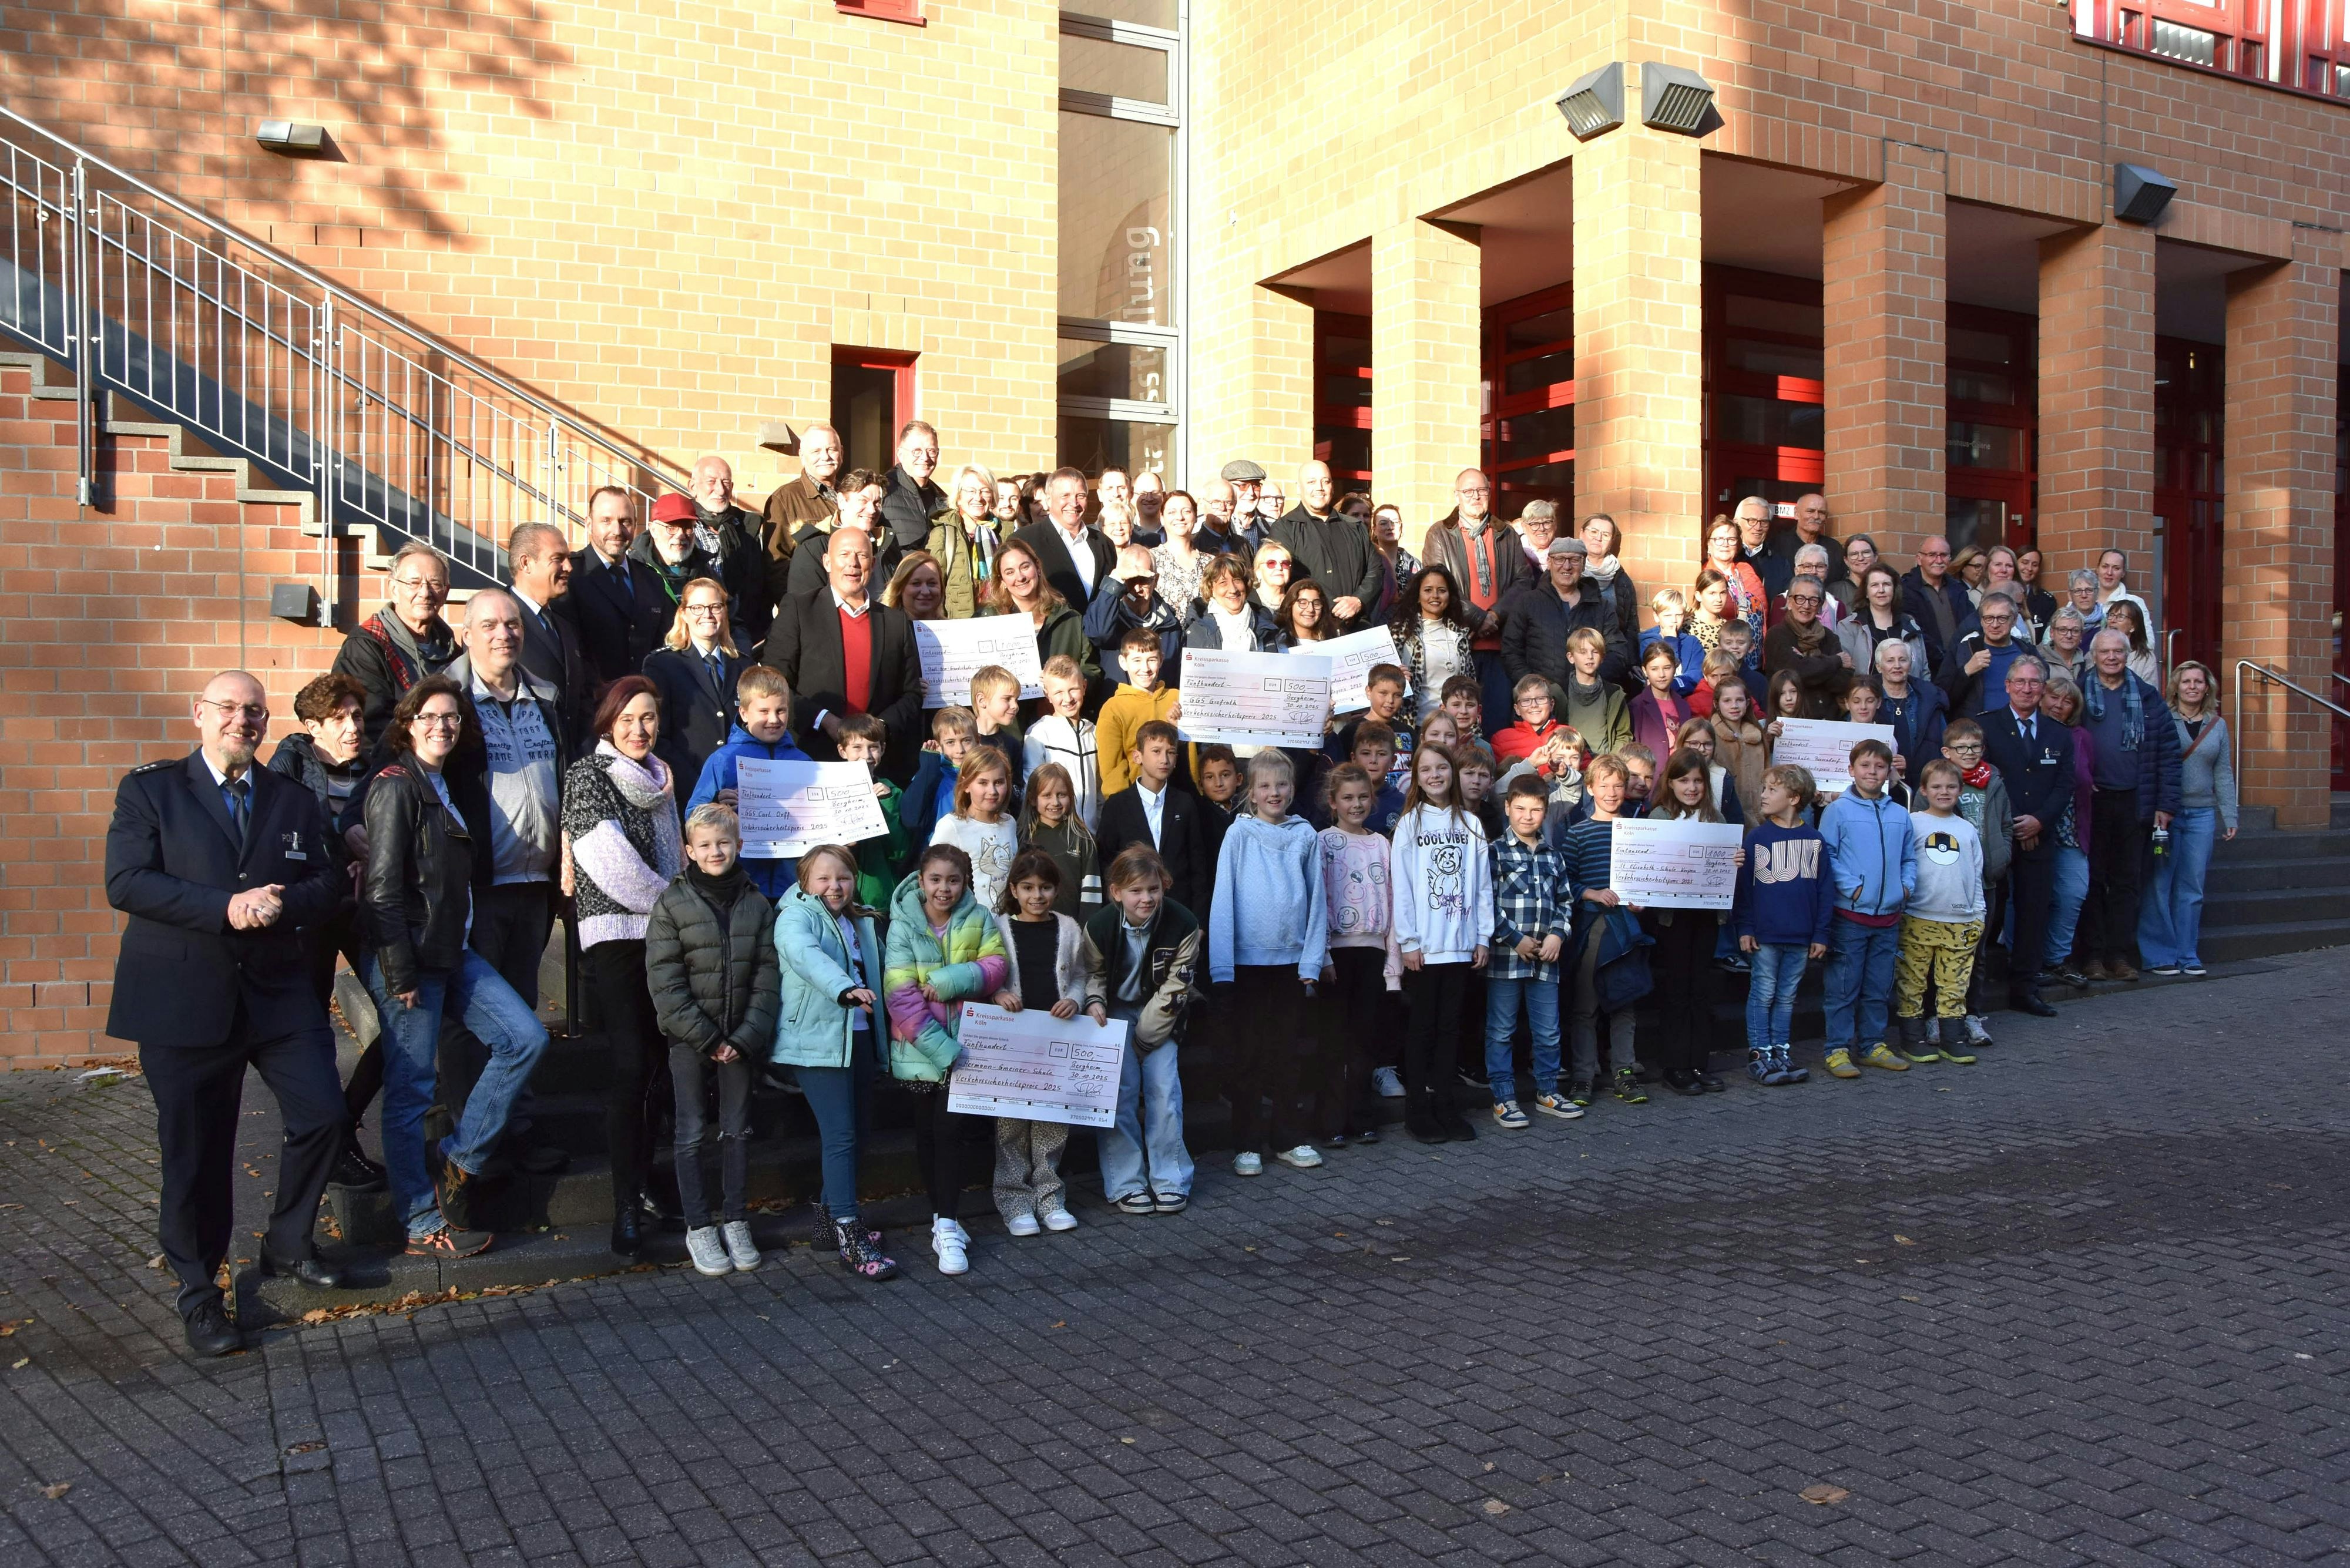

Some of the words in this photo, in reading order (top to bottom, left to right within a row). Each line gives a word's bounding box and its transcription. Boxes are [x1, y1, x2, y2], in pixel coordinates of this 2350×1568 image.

[1774, 505, 1790, 515] BMZ
[1187, 679, 1225, 687] Fünfhundert
[524, 738, 554, 748] Crafted
[488, 752, 513, 762] RADE
[529, 749, 555, 760] MARK
[776, 810, 790, 820] Orff
[1417, 833, 1445, 847] COOL
[1445, 833, 1469, 845] VIBES
[975, 1012, 1015, 1022] Kreissparkasse
[964, 1039, 1007, 1050] Fünfhundert
[956, 1074, 1039, 1091] Verkehrssicherheitspreis
[1044, 1083, 1062, 1091] 2025
